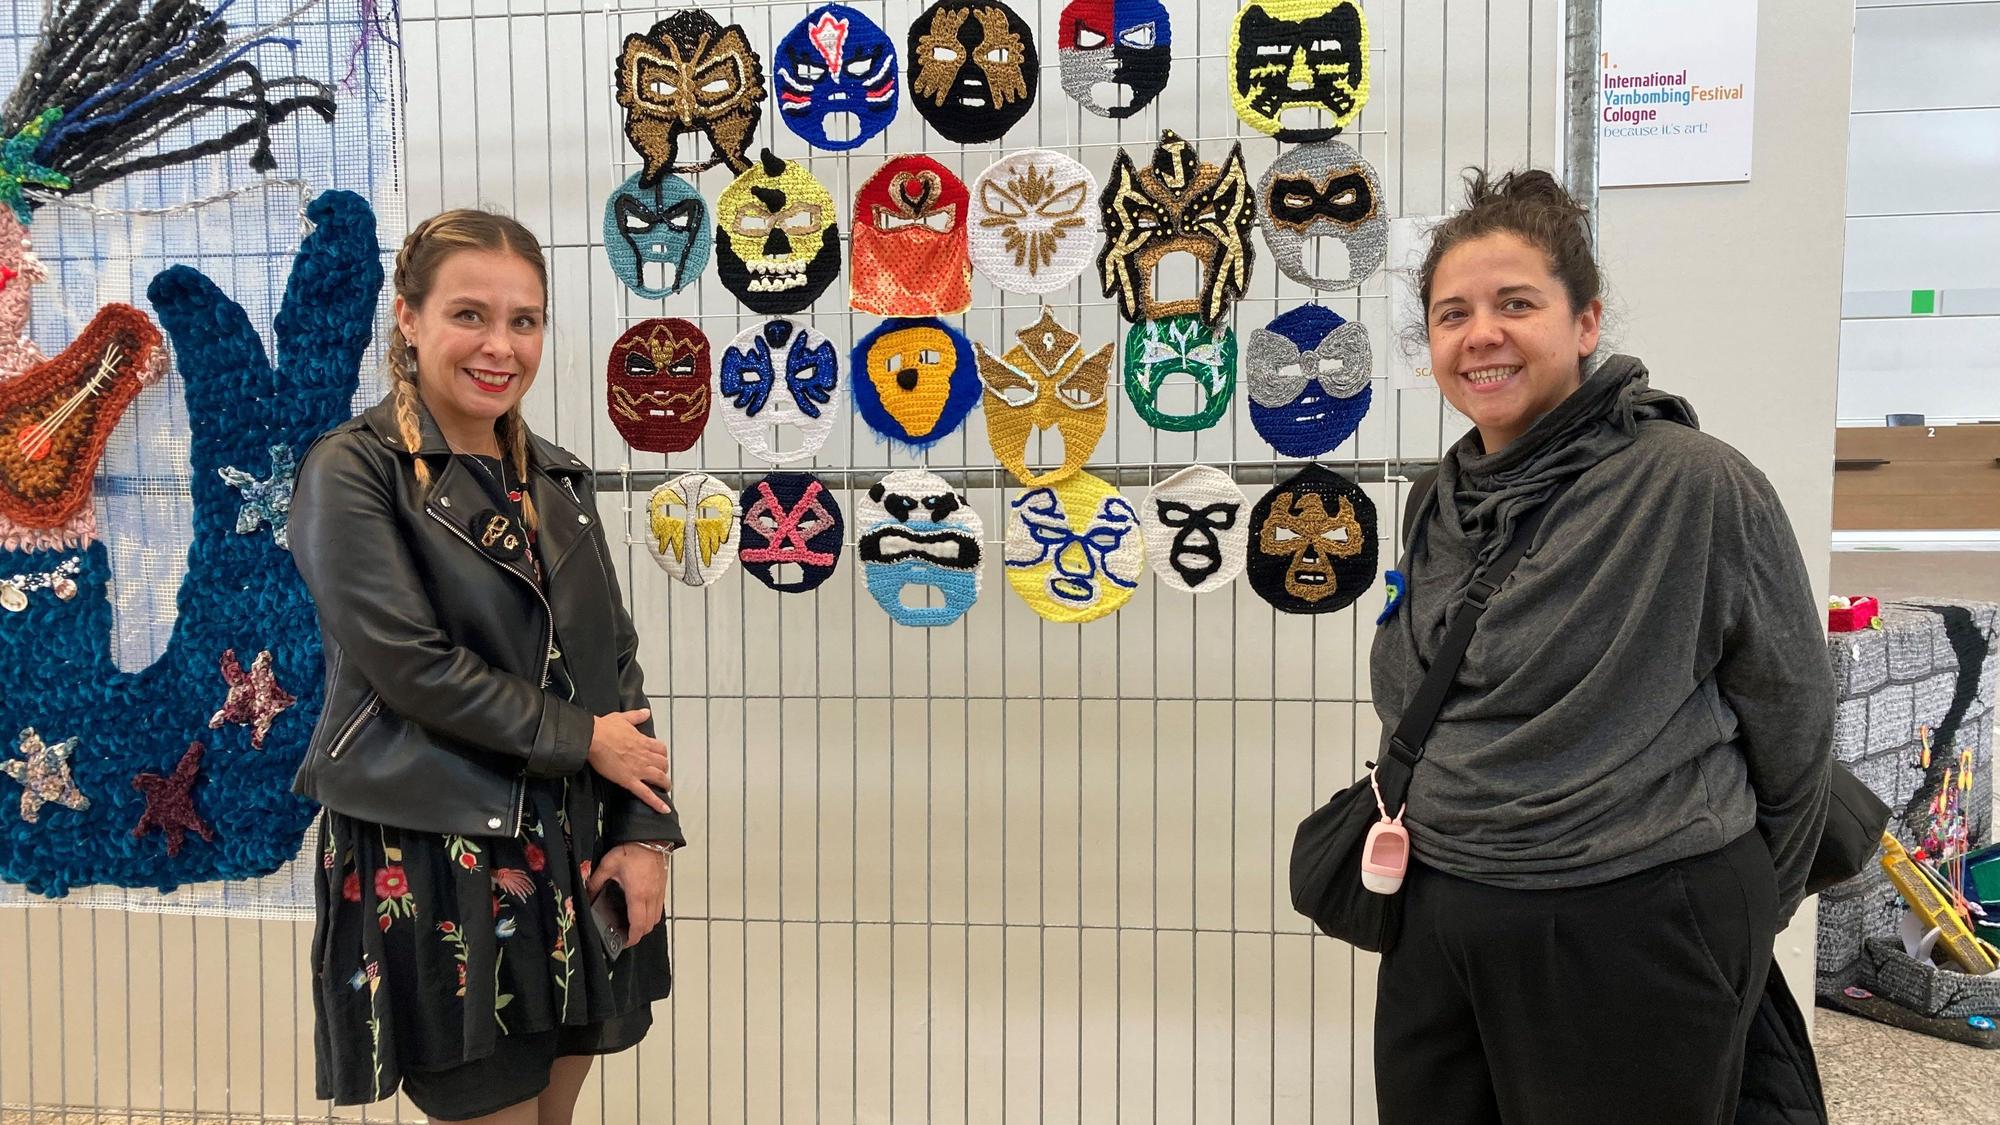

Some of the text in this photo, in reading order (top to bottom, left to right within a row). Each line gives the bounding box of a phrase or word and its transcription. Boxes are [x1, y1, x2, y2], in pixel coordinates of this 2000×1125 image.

[1601, 52, 1617, 69] 1.
[1604, 70, 1687, 89] International
[1603, 107, 1657, 125] Cologne
[1603, 122, 1708, 138] because it's art!
[1927, 427, 1936, 438] 2
